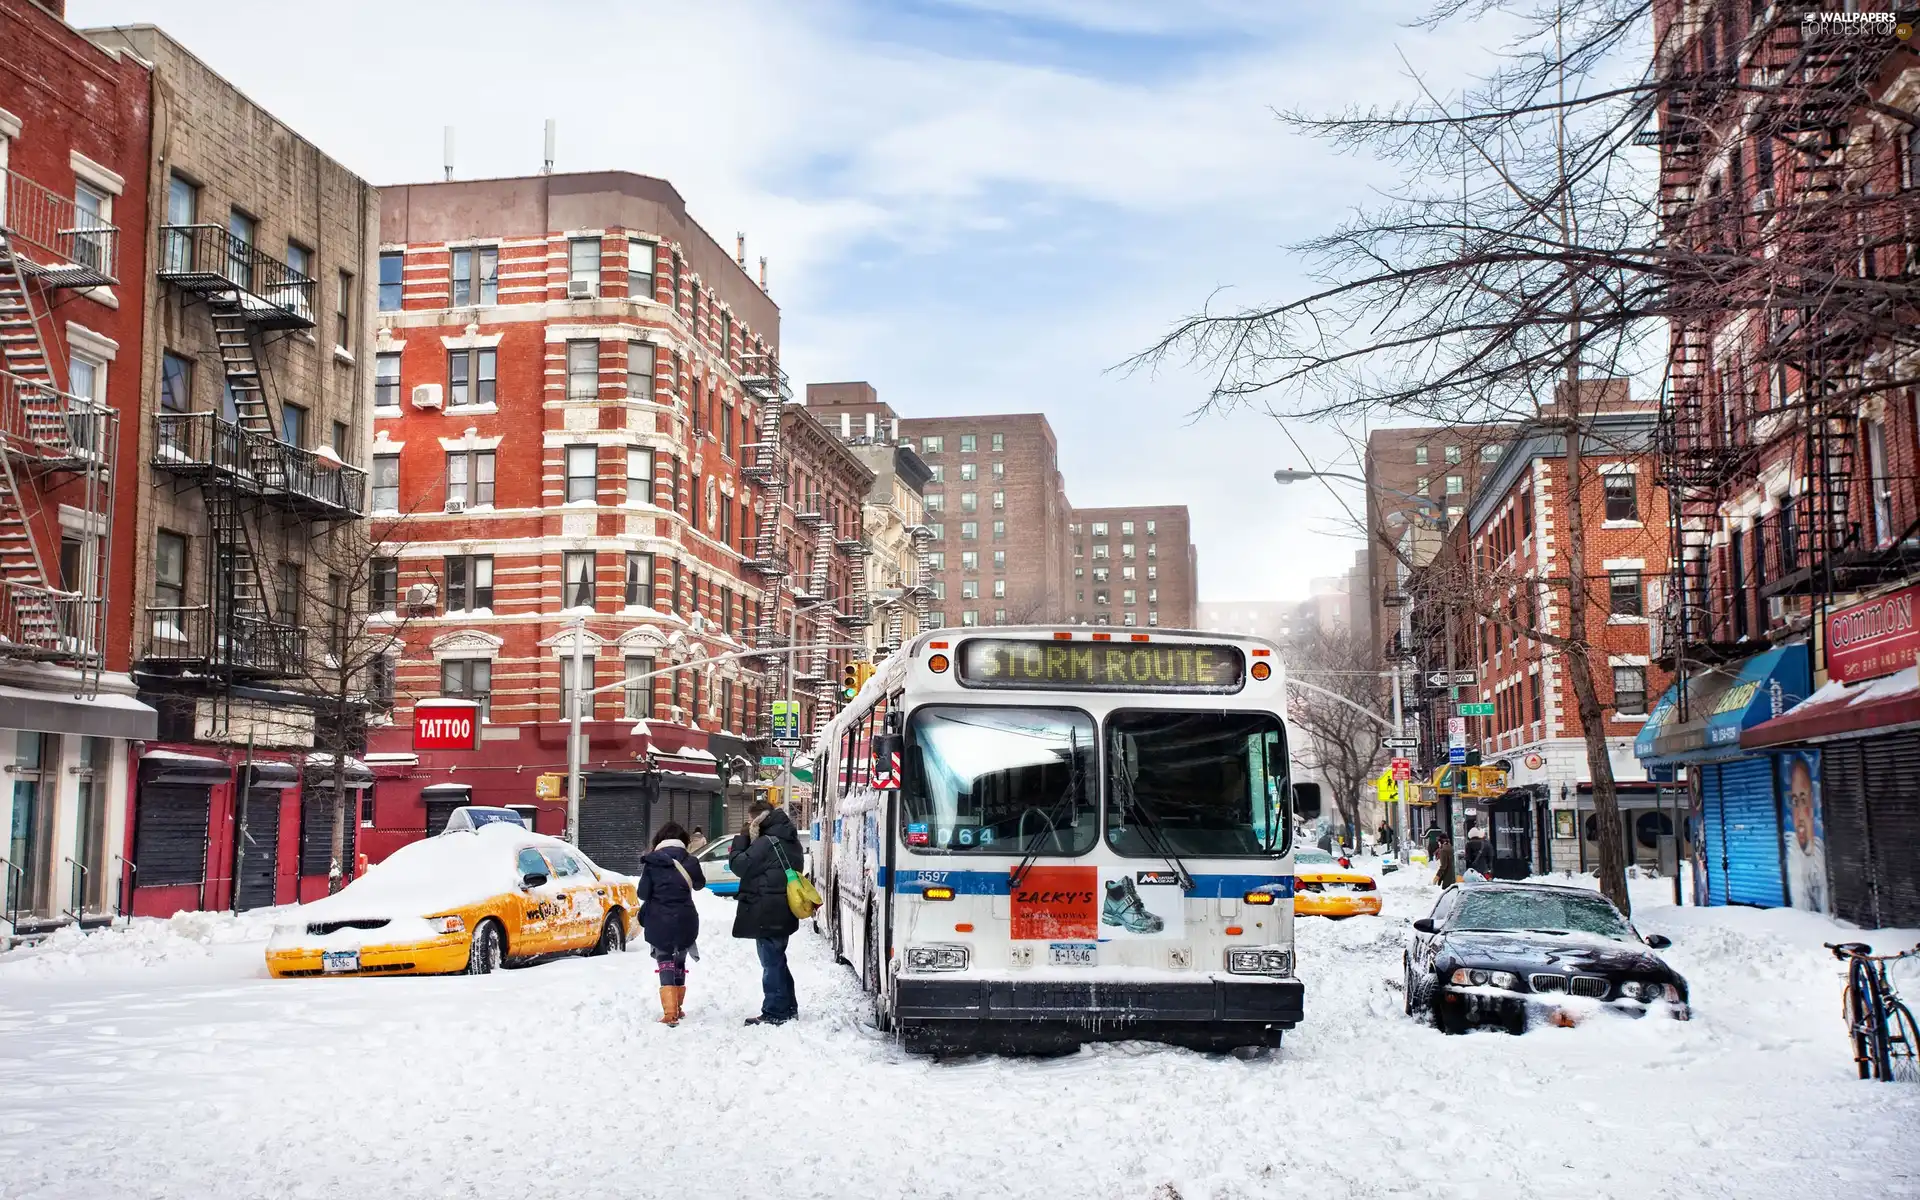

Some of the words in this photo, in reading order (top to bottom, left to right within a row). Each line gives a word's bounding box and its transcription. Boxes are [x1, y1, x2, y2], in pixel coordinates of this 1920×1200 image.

[981, 645, 1093, 679] STORM
[1107, 648, 1216, 682] ROUTE
[1862, 658, 1877, 672] BAR
[1881, 652, 1897, 665] AND
[1433, 676, 1448, 684] ONE
[1461, 705, 1467, 714] E
[1470, 705, 1482, 714] 13
[420, 719, 470, 738] TATTOO
[917, 871, 949, 882] 5597
[1016, 891, 1094, 905] ZACKY'S
[1037, 911, 1088, 919] BROADWAY
